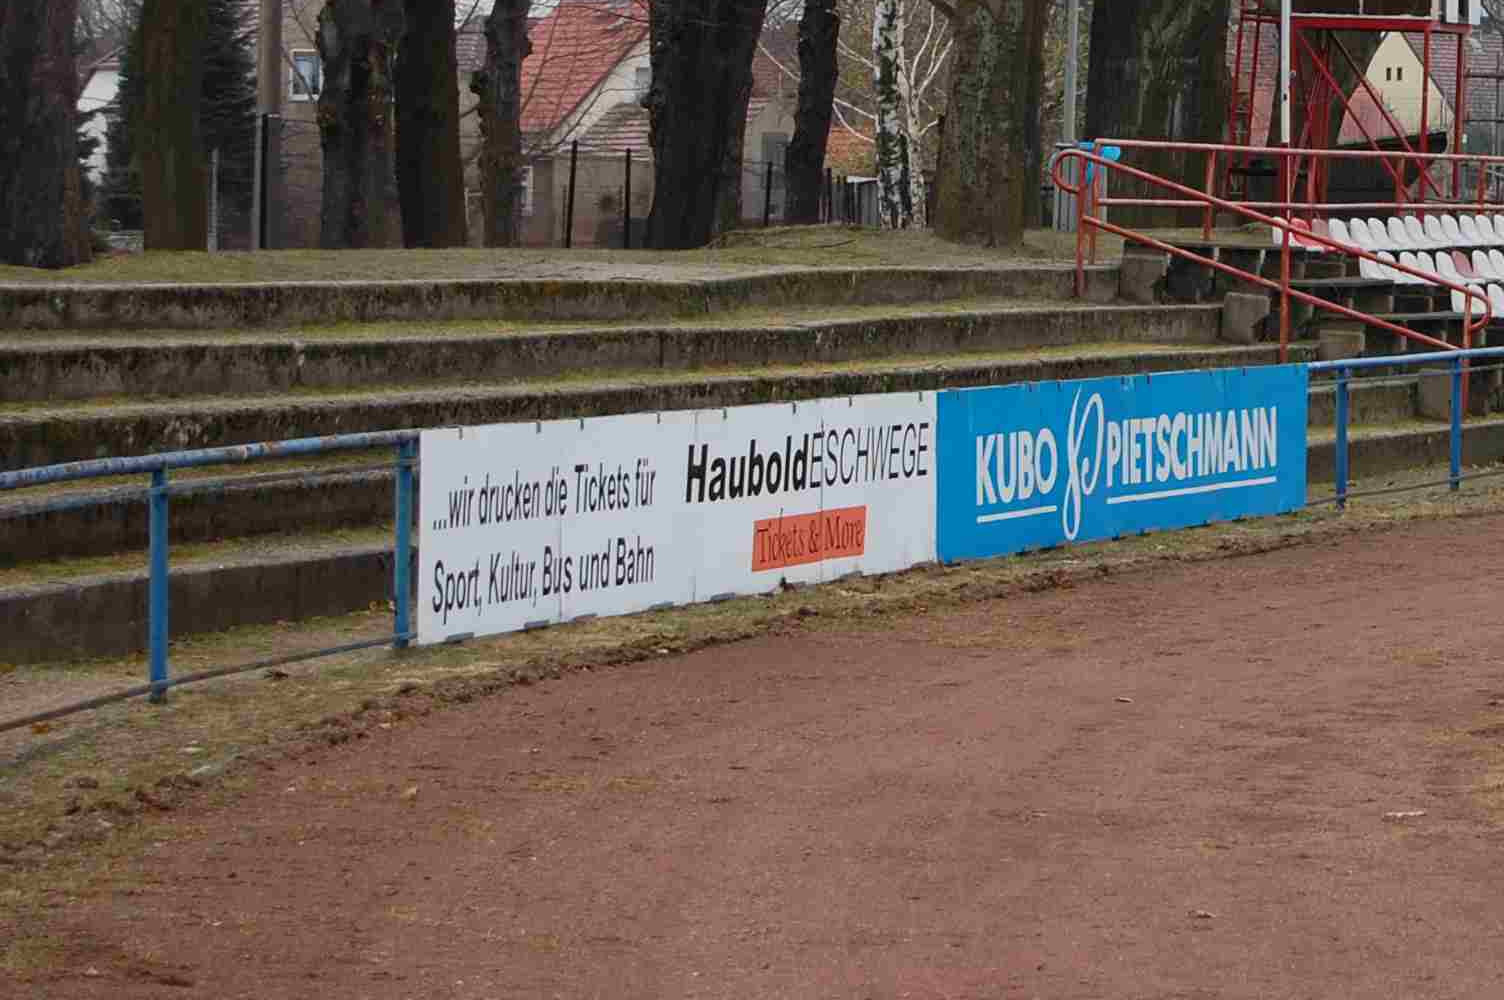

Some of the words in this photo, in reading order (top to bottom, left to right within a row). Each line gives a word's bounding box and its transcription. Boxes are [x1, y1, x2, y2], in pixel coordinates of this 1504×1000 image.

[478, 469, 541, 525] drucken
[544, 465, 568, 518] die
[574, 462, 631, 514] Tickets
[634, 457, 656, 508] für
[975, 427, 1058, 506] KUBO
[1105, 406, 1278, 488] PIETSCHMANN
[756, 519, 805, 564] Tickets
[808, 520, 820, 554] &
[823, 515, 865, 552] More
[432, 559, 482, 626] Sport,
[487, 550, 538, 609] Kultur,
[542, 545, 573, 596] Bus
[578, 538, 612, 592] und
[614, 535, 655, 587] Bahn
